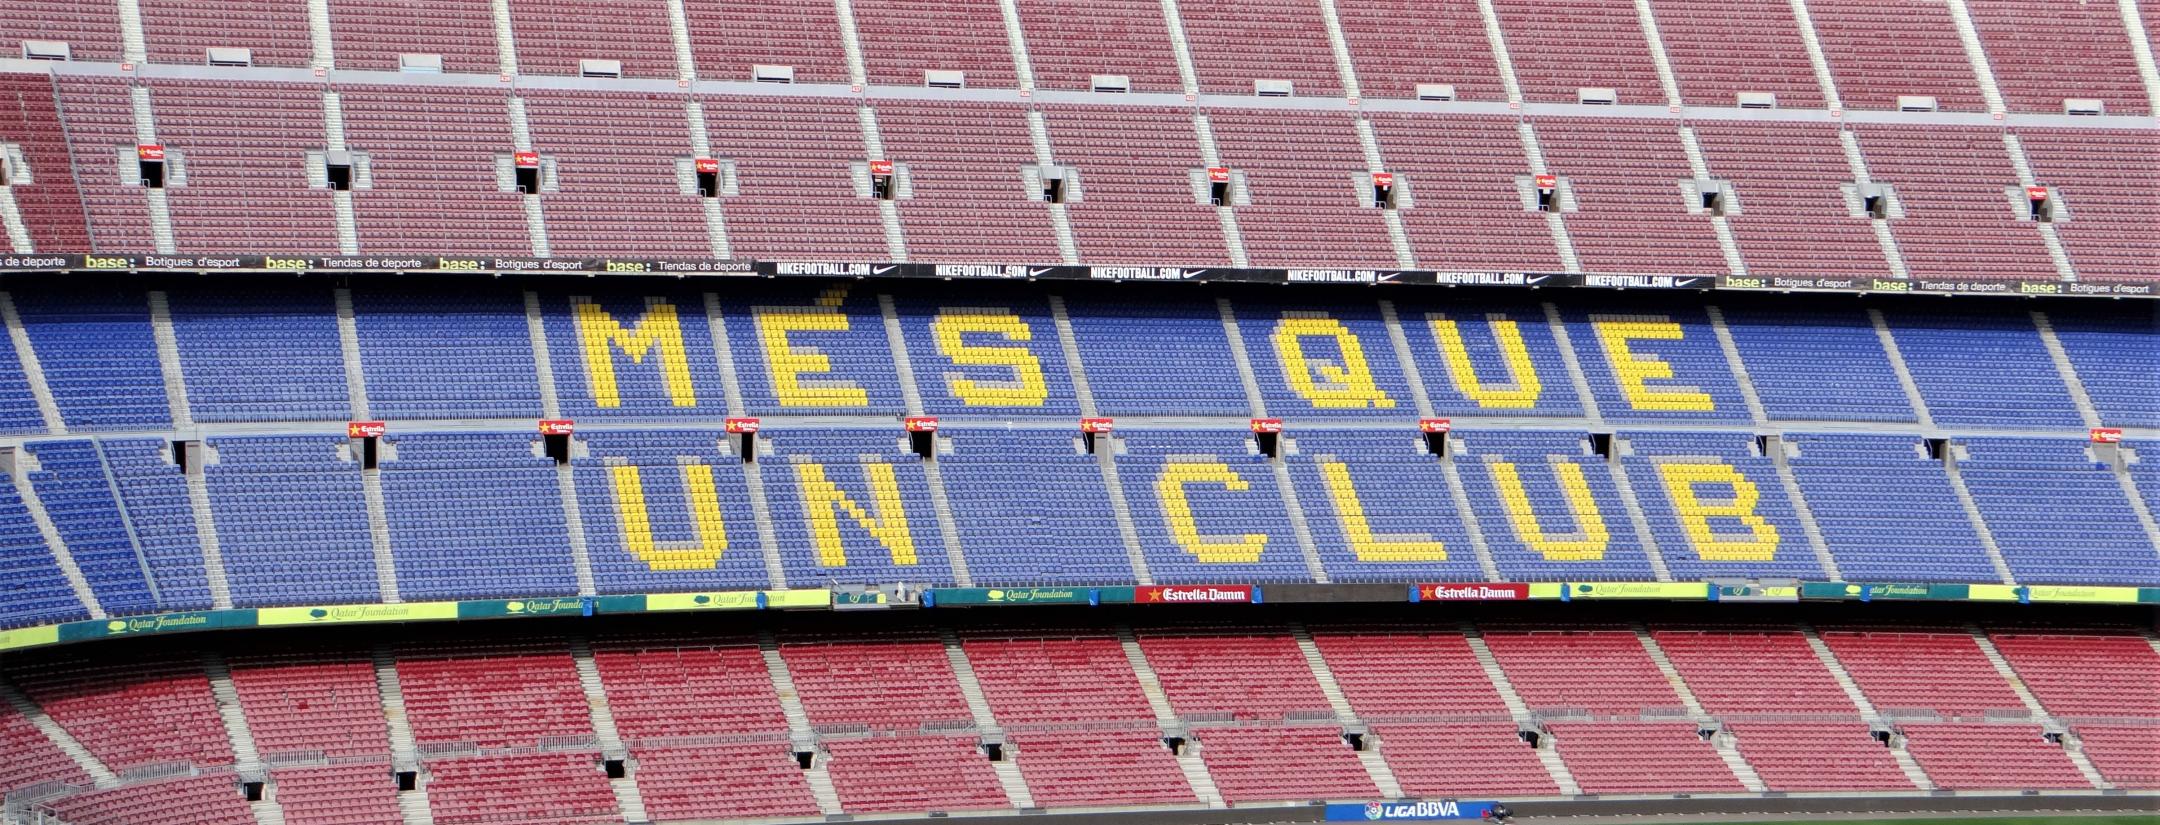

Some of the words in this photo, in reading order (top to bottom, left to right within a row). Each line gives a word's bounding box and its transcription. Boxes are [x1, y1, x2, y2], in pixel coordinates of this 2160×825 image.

[5, 257, 19, 267] de
[22, 256, 66, 269] deporte
[145, 256, 193, 269] Botigues
[198, 256, 241, 269] d'esport
[322, 257, 363, 268] Tiendas
[365, 257, 379, 268] de
[381, 257, 422, 270] deporte
[495, 258, 539, 270] Botigues
[543, 259, 583, 271] d'esport
[658, 261, 697, 271] Tiendas
[699, 261, 712, 271] de
[713, 261, 751, 272] deporte
[776, 262, 870, 276] NIKEFOOTBALL.COM
[935, 264, 1027, 277] NIKEFOOTBALL.COM
[1090, 266, 1181, 280] NIKEFOOTBALL.COM
[1287, 269, 1376, 282] NIKEFOOTBALL.COM
[1436, 271, 1524, 285] NIKEFOOTBALL.COM
[1585, 274, 1673, 288] NIKEFOOTBALL.COM
[1774, 277, 1813, 289] Botigues
[1816, 278, 1851, 289] d'esport
[1920, 281, 1954, 291] Tiendas
[1957, 281, 1969, 291] de
[1971, 281, 2006, 292] deporte
[2070, 283, 2110, 295] Botigues
[2113, 283, 2149, 295] d'esport
[577, 284, 1048, 406] MÉS
[1277, 317, 1714, 410] QUE
[611, 463, 918, 571] UN
[1160, 461, 1781, 563] CLUB
[1006, 589, 1030, 602] Qatar
[1028, 588, 1073, 601] Foundation
[1163, 587, 1208, 601] Estrella
[1208, 587, 1246, 602] Damm
[1434, 585, 1478, 599] Estrella
[1479, 585, 1516, 599] Damm
[1868, 585, 1886, 596] atar
[526, 600, 551, 613] Qatar
[129, 618, 155, 632] Qatar
[154, 613, 207, 630] Foundation
